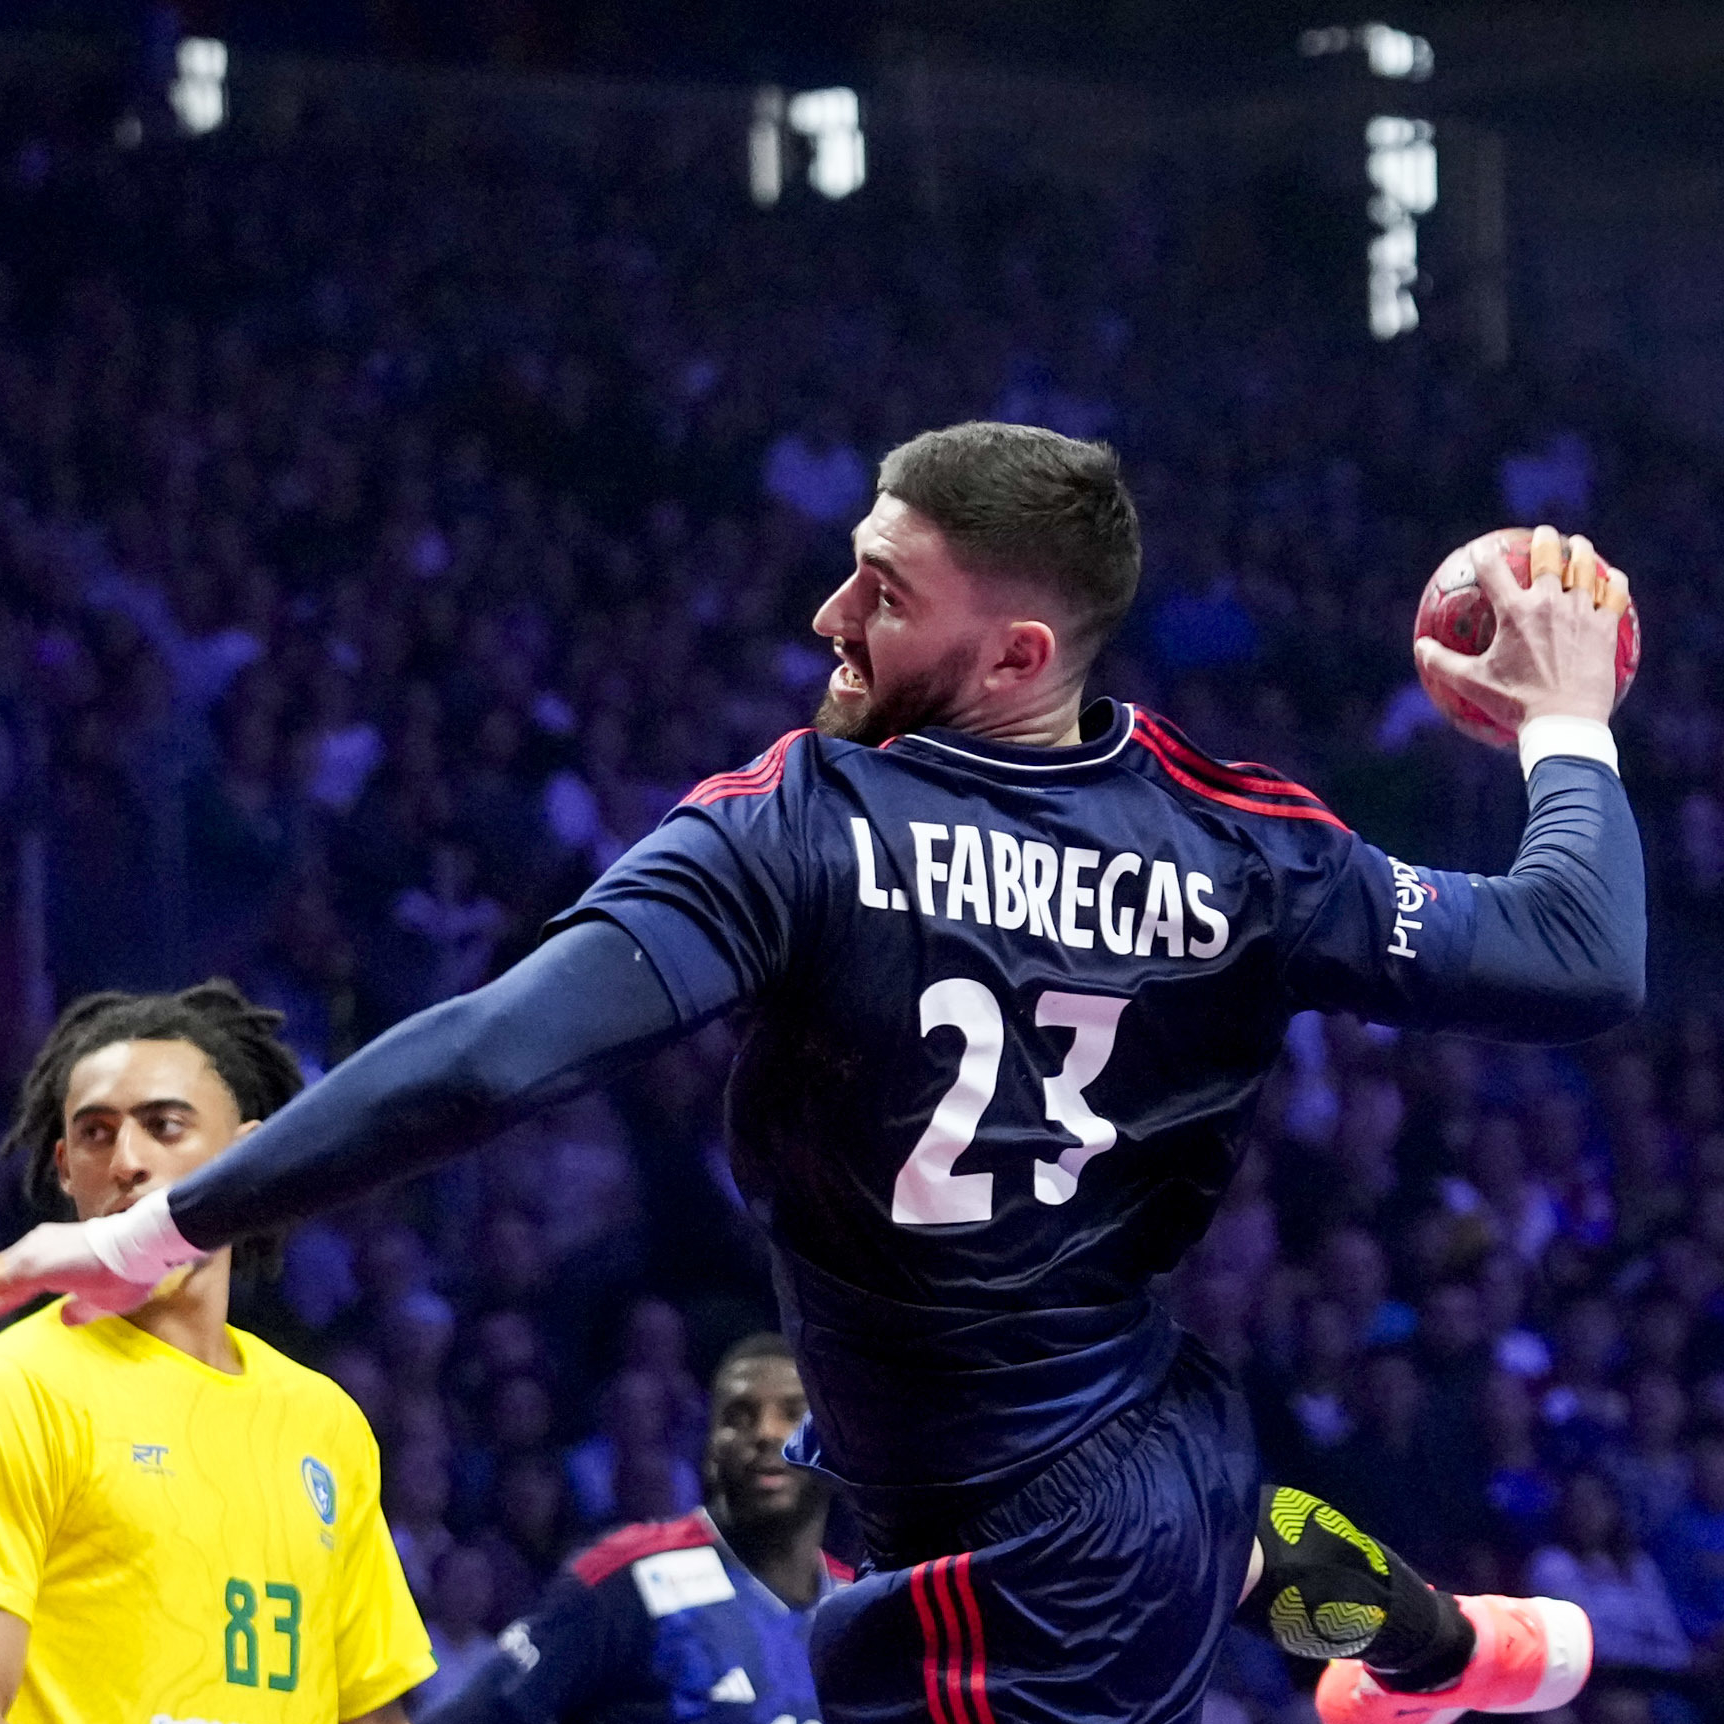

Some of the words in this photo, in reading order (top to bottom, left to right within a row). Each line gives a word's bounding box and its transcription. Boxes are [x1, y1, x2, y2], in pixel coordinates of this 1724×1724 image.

[850, 815, 1229, 960] L.FABREGAS
[892, 978, 1130, 1224] 23
[224, 1576, 302, 1693] 83
